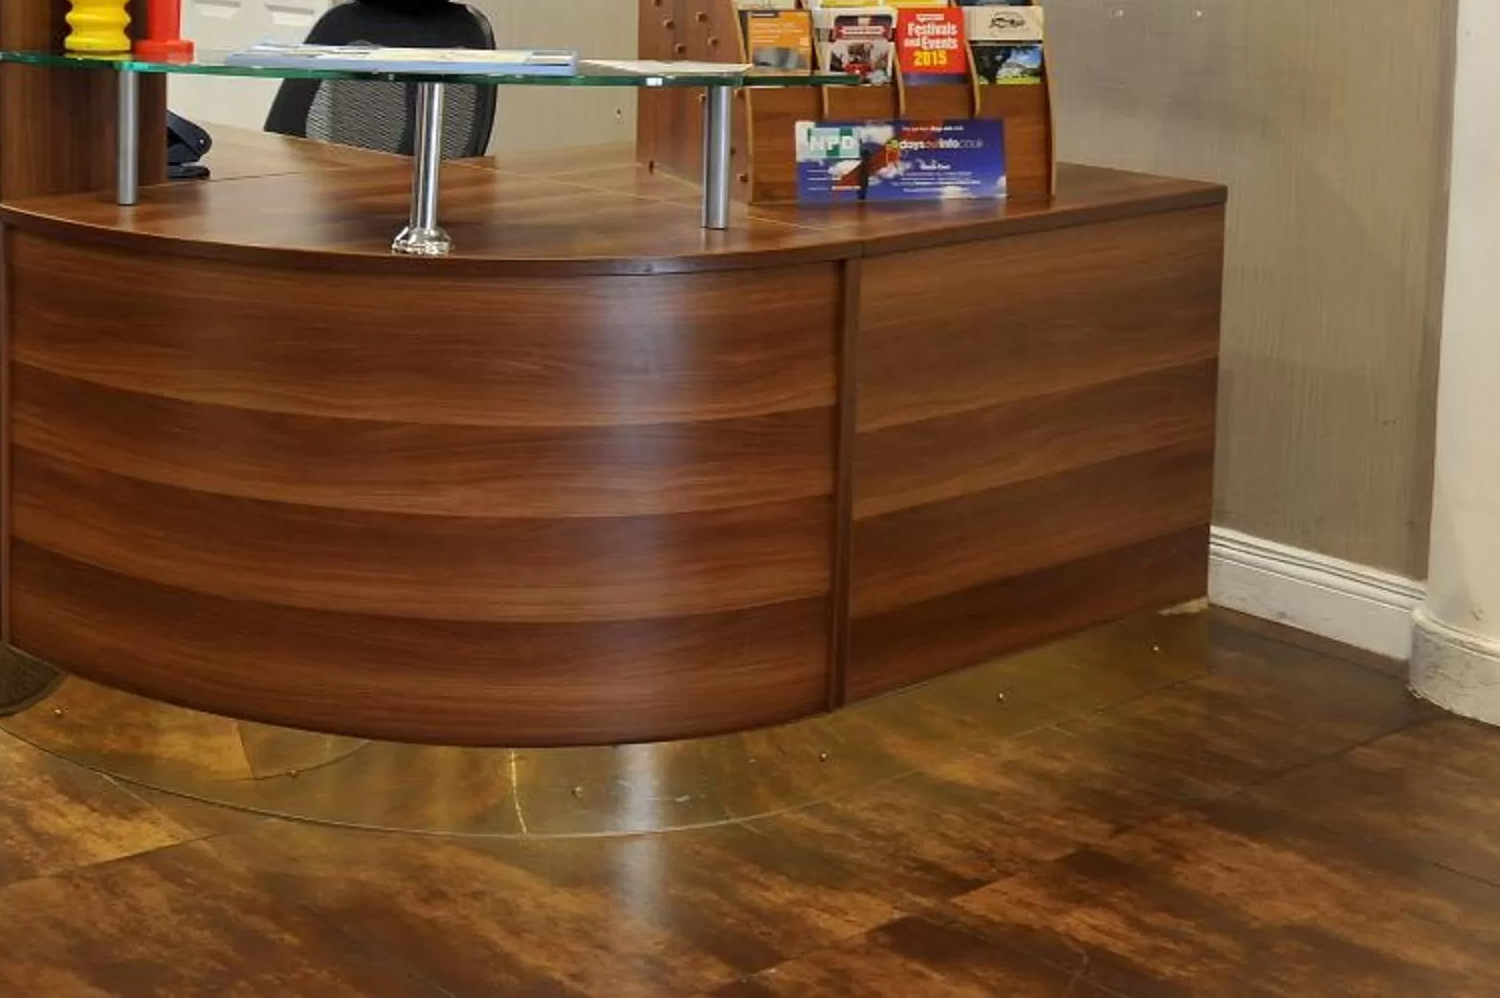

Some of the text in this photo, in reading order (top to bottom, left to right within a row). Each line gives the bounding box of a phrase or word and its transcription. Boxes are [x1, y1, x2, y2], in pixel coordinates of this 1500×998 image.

[907, 22, 958, 36] Festivals
[904, 36, 959, 50] and Events
[913, 50, 948, 67] 2015
